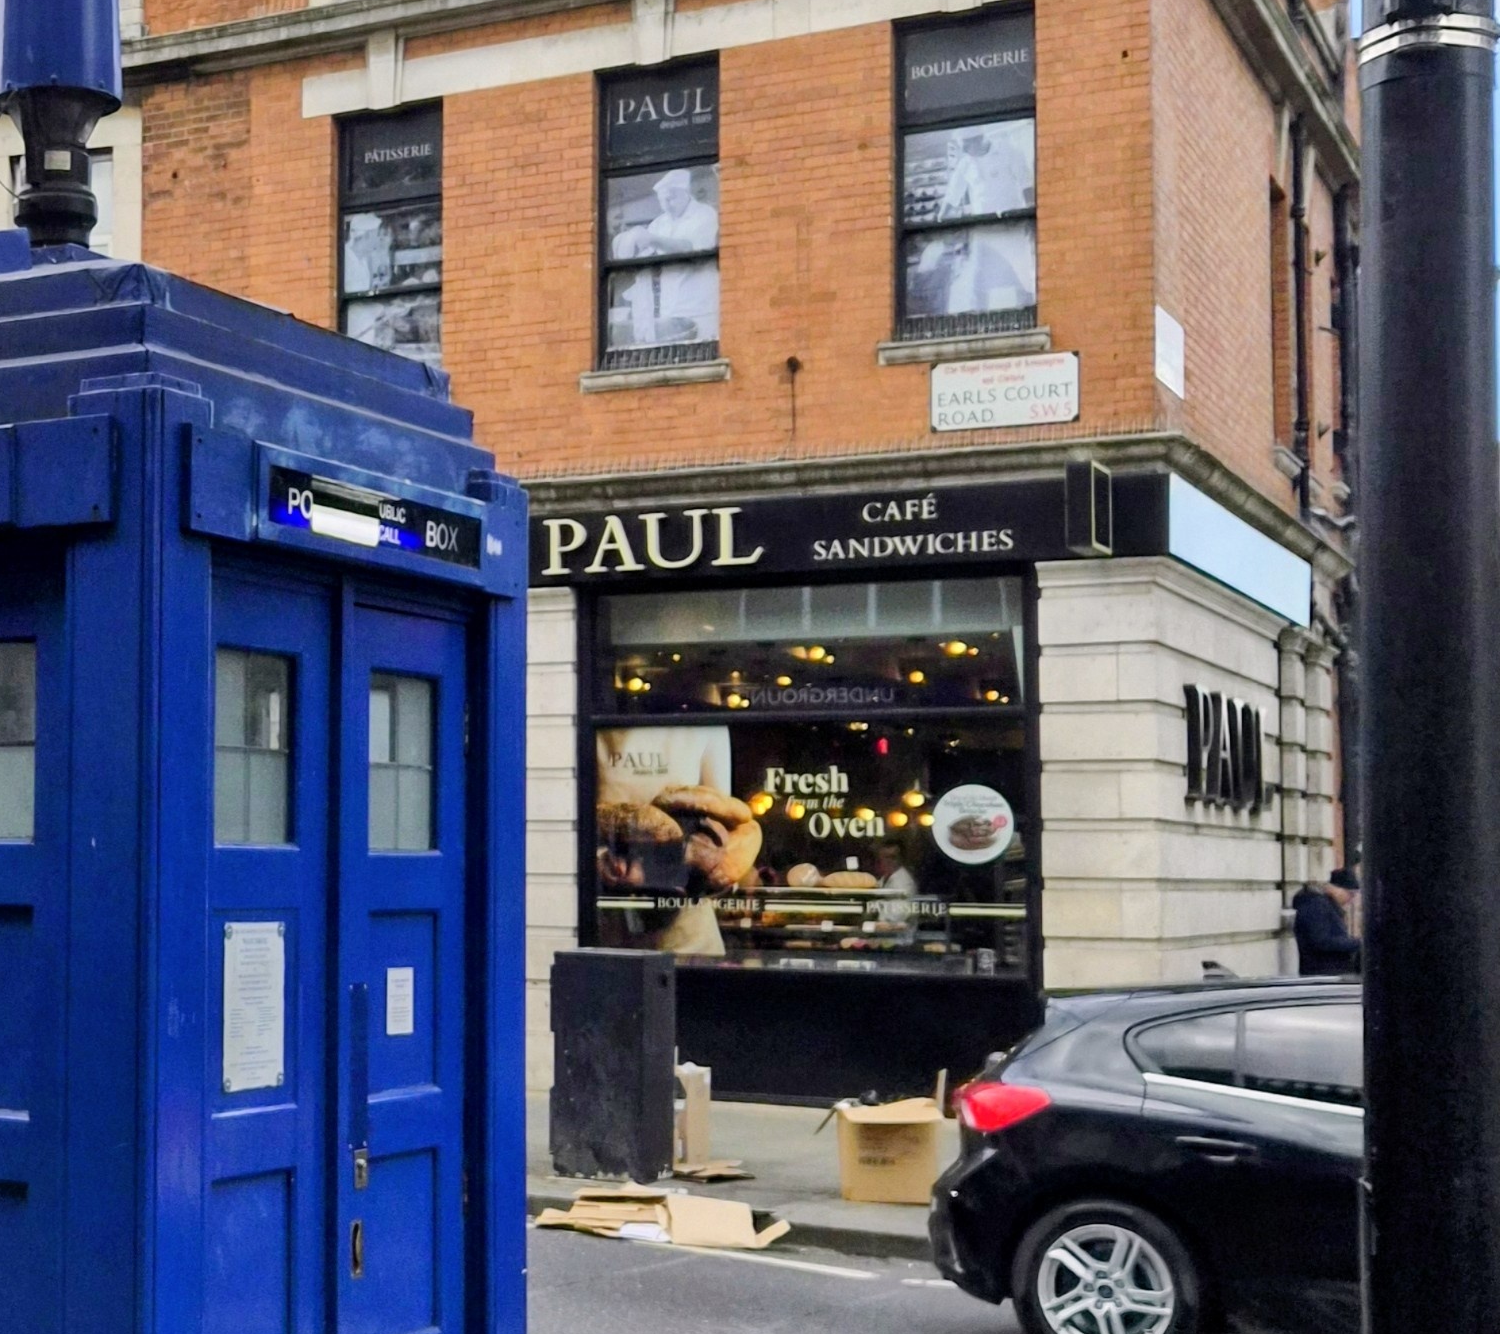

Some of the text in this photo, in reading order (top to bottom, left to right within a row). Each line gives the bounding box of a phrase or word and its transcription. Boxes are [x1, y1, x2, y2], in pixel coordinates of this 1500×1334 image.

[911, 48, 1029, 80] BOULANGERIE
[615, 87, 713, 126] PAUL
[937, 381, 1073, 407] EARLS COURT
[937, 407, 995, 427] ROAD
[379, 502, 406, 524] UBLIC
[861, 493, 939, 524] CAFÉ
[425, 519, 459, 552] BOX
[540, 506, 765, 577] PAUL
[812, 528, 1015, 562] SANDWICHES
[610, 751, 670, 768] PAUL
[764, 764, 850, 795] Fresh
[822, 793, 845, 810] the
[808, 811, 886, 839] Oven
